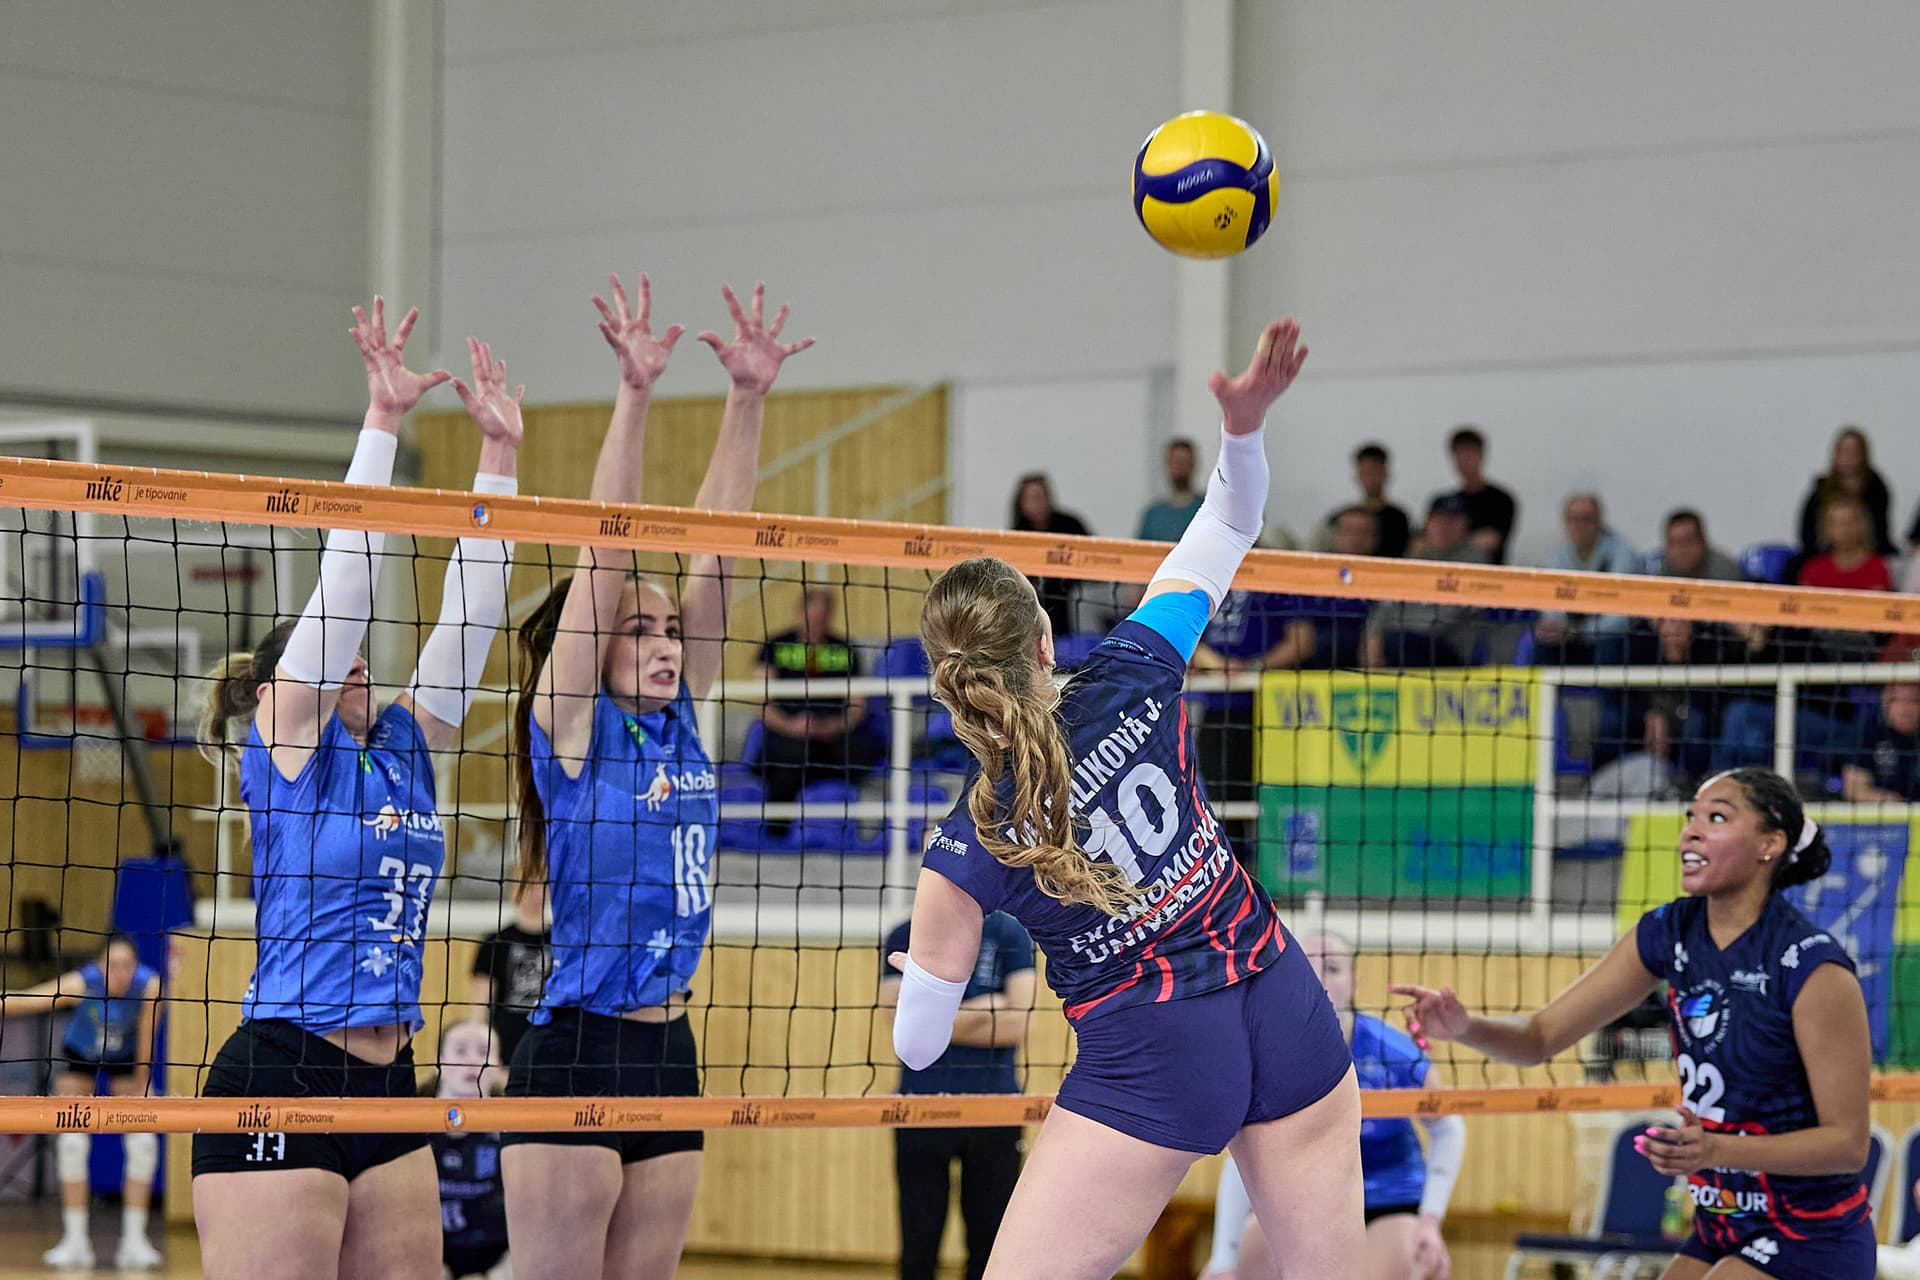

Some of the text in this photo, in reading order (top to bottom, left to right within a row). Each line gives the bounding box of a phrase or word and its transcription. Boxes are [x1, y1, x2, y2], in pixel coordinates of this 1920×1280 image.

[86, 476, 187, 501] niké je tipovanie
[266, 489, 363, 513] niké je tipovanie
[599, 513, 631, 537] niké
[755, 525, 786, 547] niké
[1144, 696, 1163, 722] J.
[1082, 762, 1180, 886] 10
[671, 823, 713, 918] 18
[1068, 801, 1219, 954] EKONOMICKÁ
[367, 855, 433, 940] 33
[1085, 842, 1230, 964] UNIVERZITA
[1677, 1053, 1726, 1123] 22
[56, 1103, 158, 1128] niké je tipovanie
[237, 1103, 335, 1128] niké je tipovanie
[574, 1103, 605, 1127] niké
[730, 1102, 761, 1126] niké
[245, 1131, 286, 1162] 33
